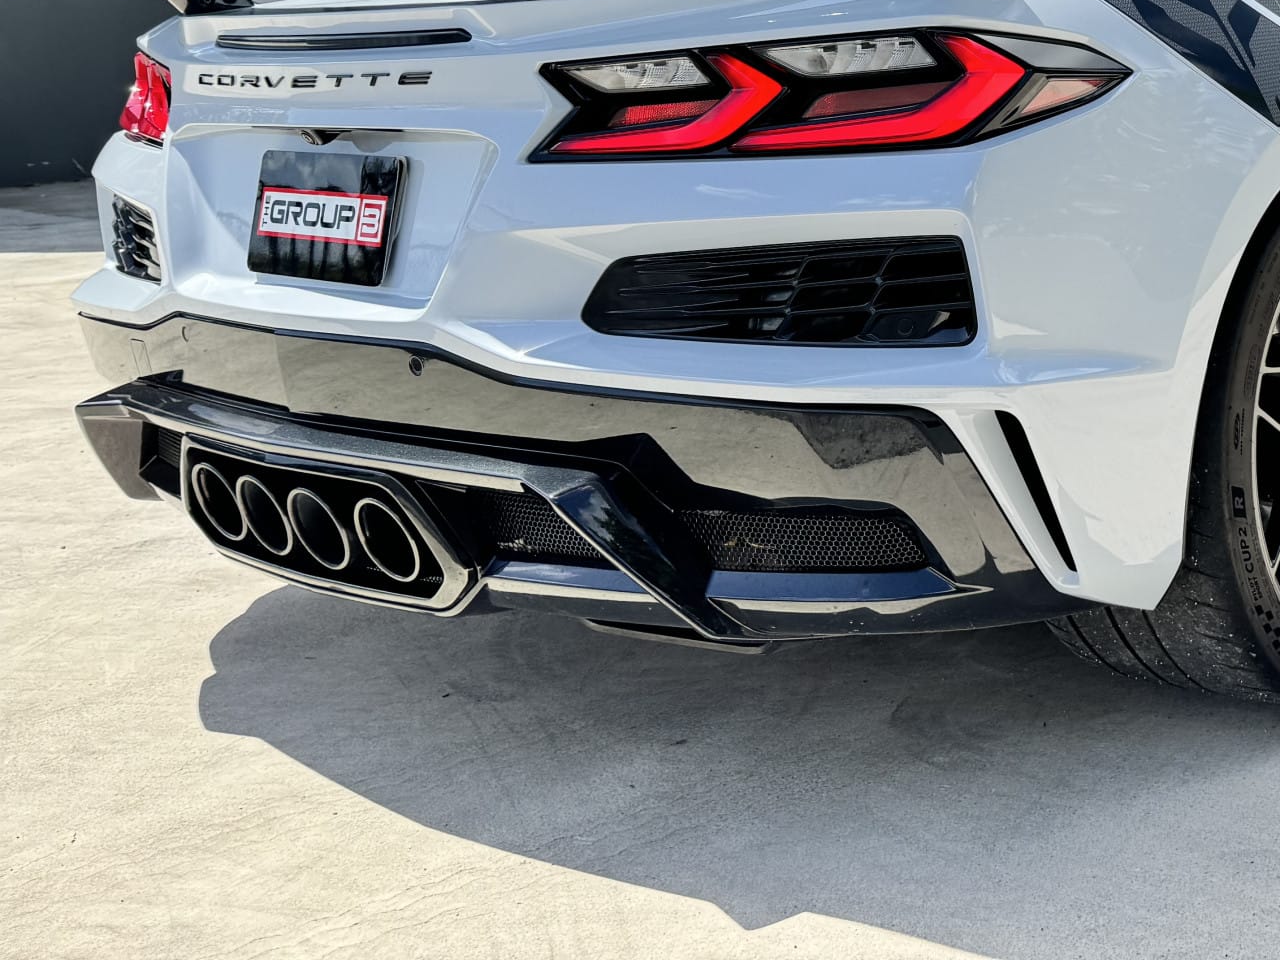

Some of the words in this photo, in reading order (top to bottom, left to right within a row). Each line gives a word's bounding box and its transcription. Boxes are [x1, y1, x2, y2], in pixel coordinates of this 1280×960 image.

[198, 70, 433, 89] CORVETTE
[269, 200, 356, 230] GROUP
[1234, 496, 1244, 509] R
[1238, 527, 1248, 537] 2
[1240, 540, 1255, 573] CUP
